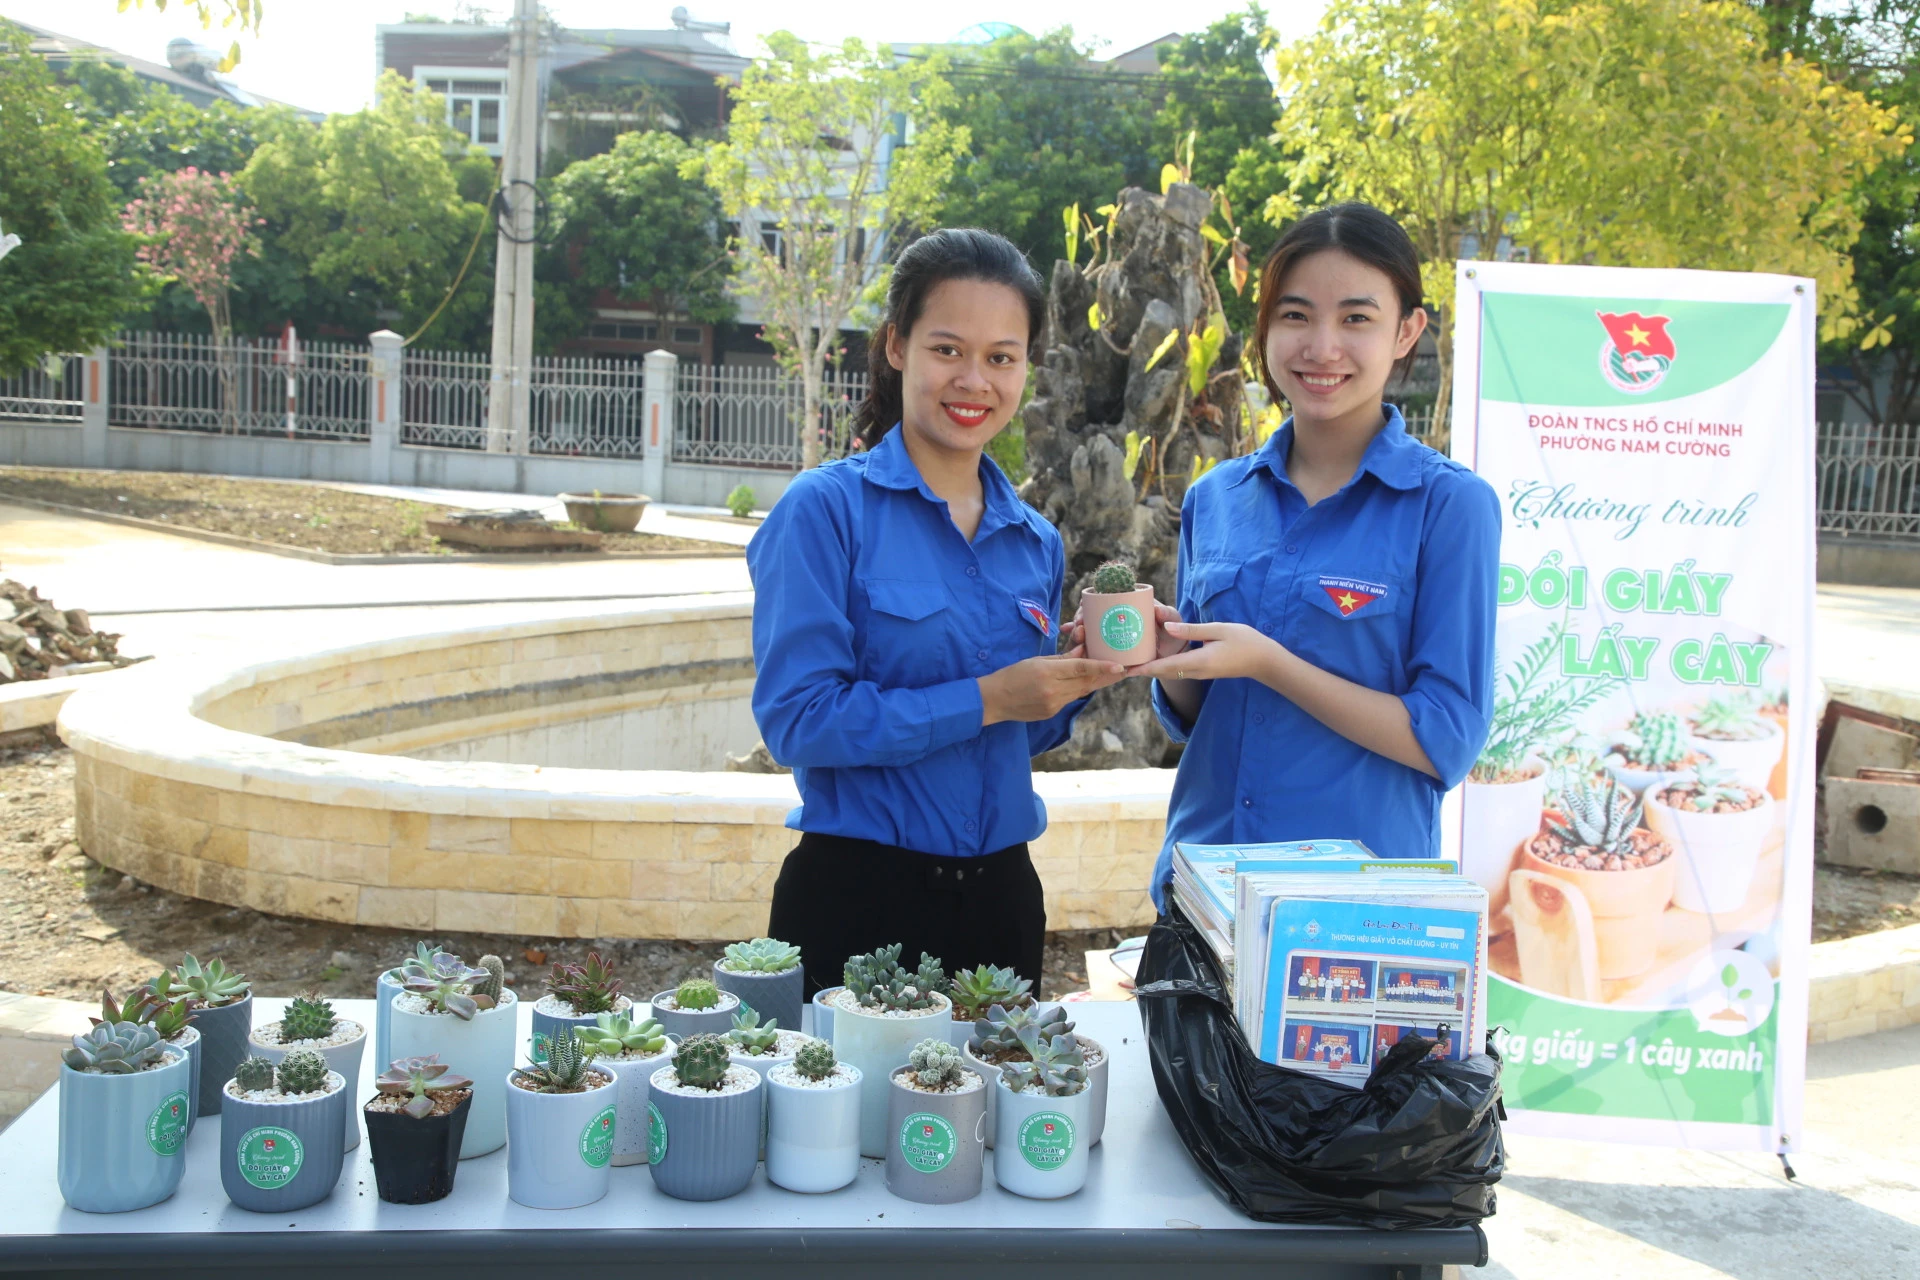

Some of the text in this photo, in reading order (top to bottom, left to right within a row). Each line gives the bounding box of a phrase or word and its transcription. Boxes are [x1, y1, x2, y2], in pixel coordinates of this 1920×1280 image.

[1528, 412, 1743, 437] ĐOÀN TNCS HỒ CHÍ MINH
[1540, 435, 1731, 457] PHƯỜNG NAM CƯỜNG
[1509, 479, 1759, 541] Chương trình
[1602, 559, 1733, 616] GIẤY
[1560, 623, 1774, 687] LẤY CÂY
[1532, 1028, 1595, 1068] giấy
[1601, 1042, 1618, 1059] =
[1624, 1036, 1636, 1064] 1
[1641, 1038, 1691, 1075] cây
[1696, 1041, 1763, 1073] xanh
